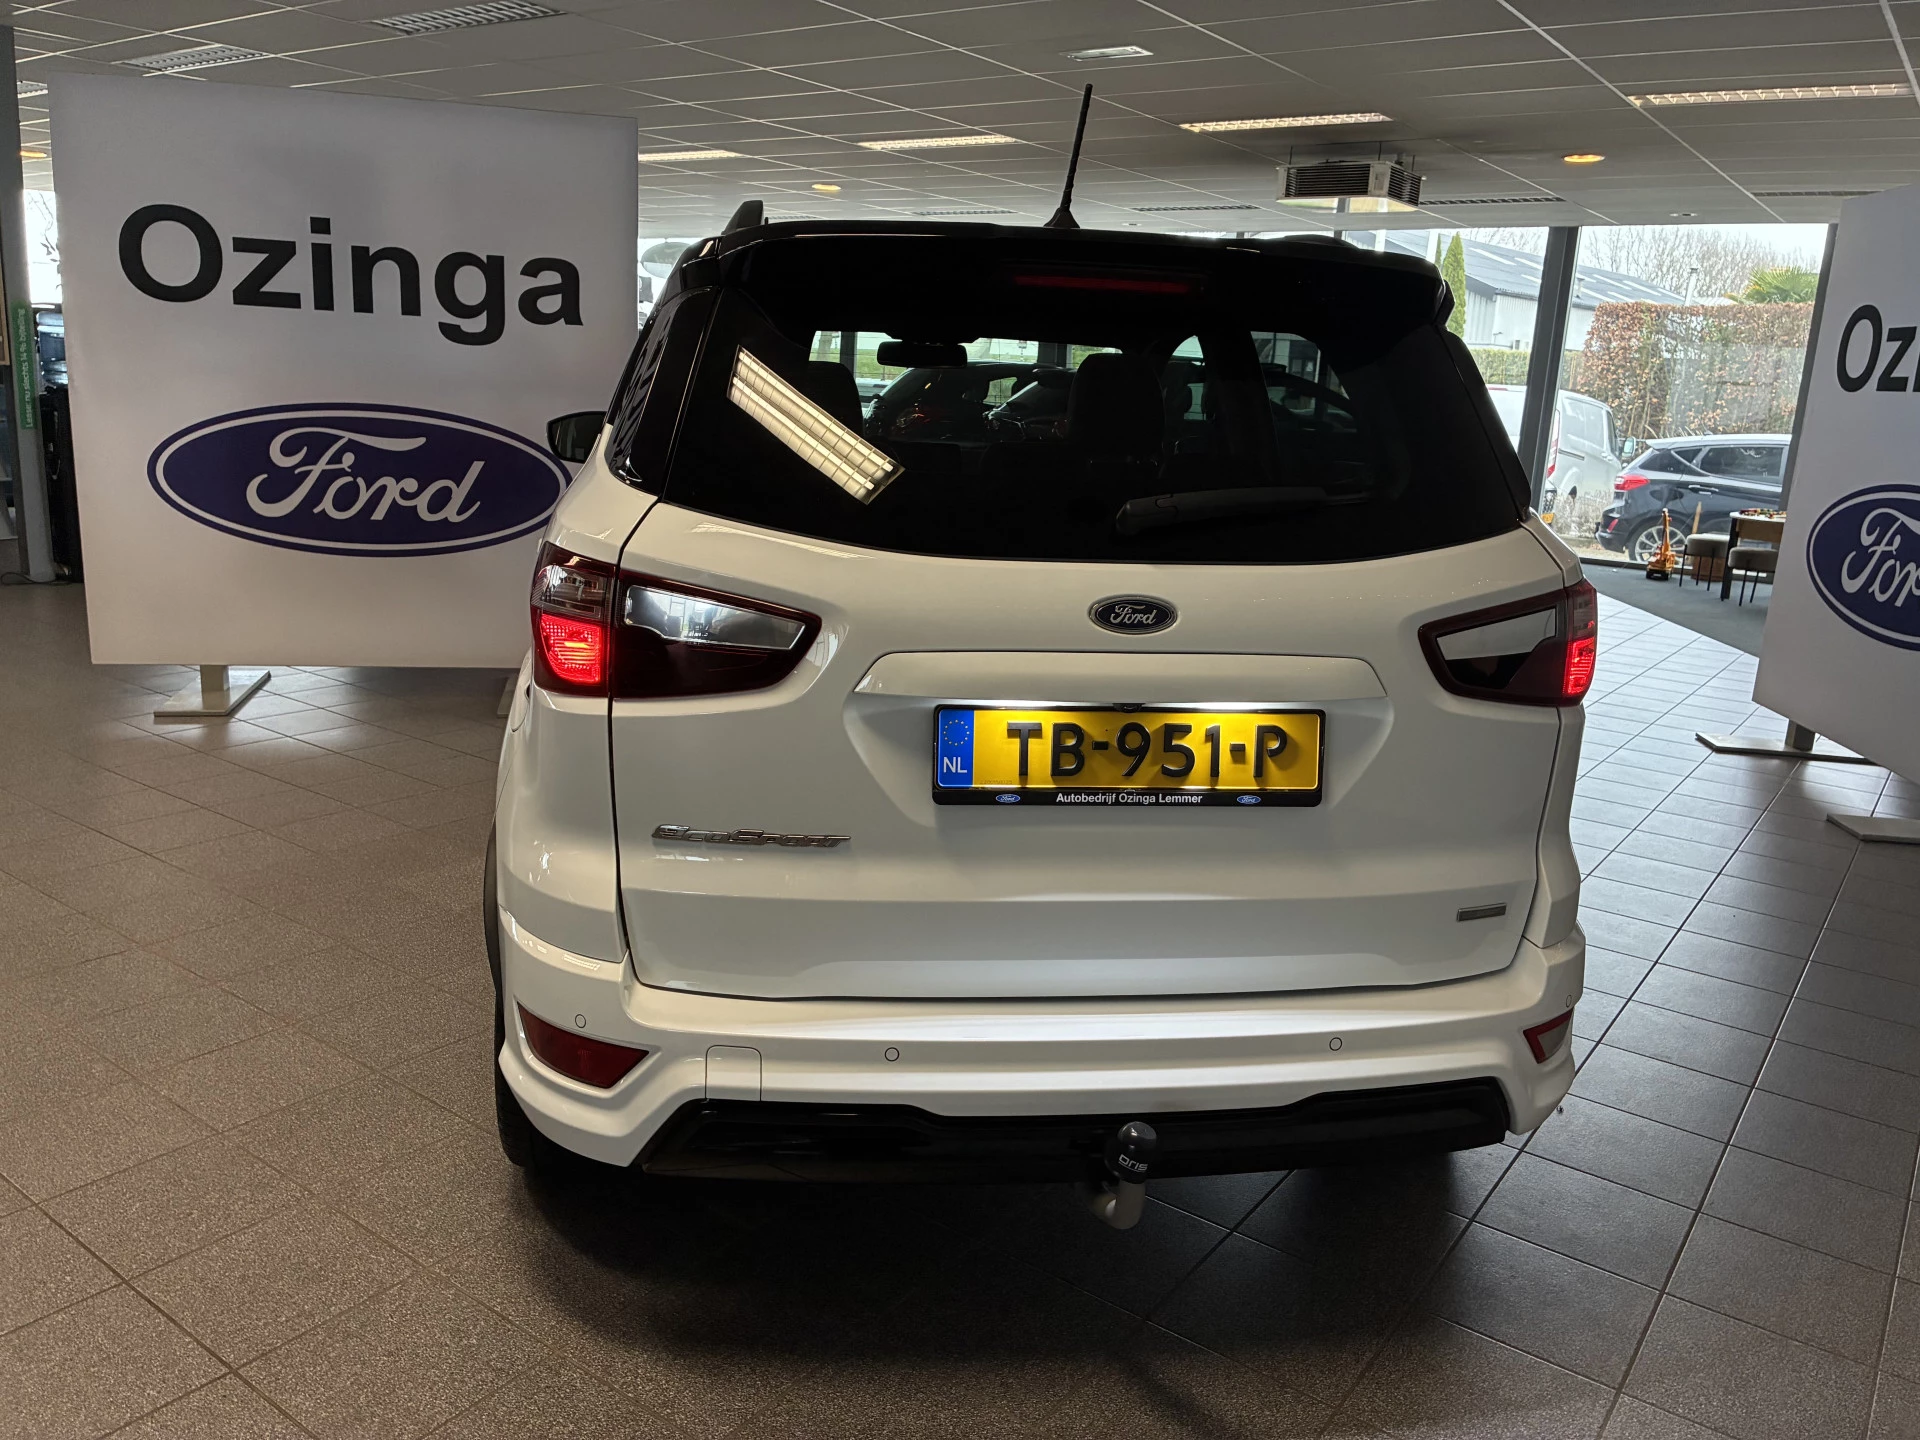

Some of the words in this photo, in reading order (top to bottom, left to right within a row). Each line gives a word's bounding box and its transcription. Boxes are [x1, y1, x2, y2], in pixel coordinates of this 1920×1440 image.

[118, 203, 584, 346] Ozinga
[246, 427, 486, 522] Ford
[1841, 507, 1920, 607] For
[1110, 604, 1157, 624] Ford
[943, 757, 967, 774] NL
[1007, 721, 1288, 778] TB-951-P
[1056, 793, 1116, 804] Autobedrijf
[1119, 793, 1156, 804] Ozinga
[1158, 794, 1203, 803] Lemmer
